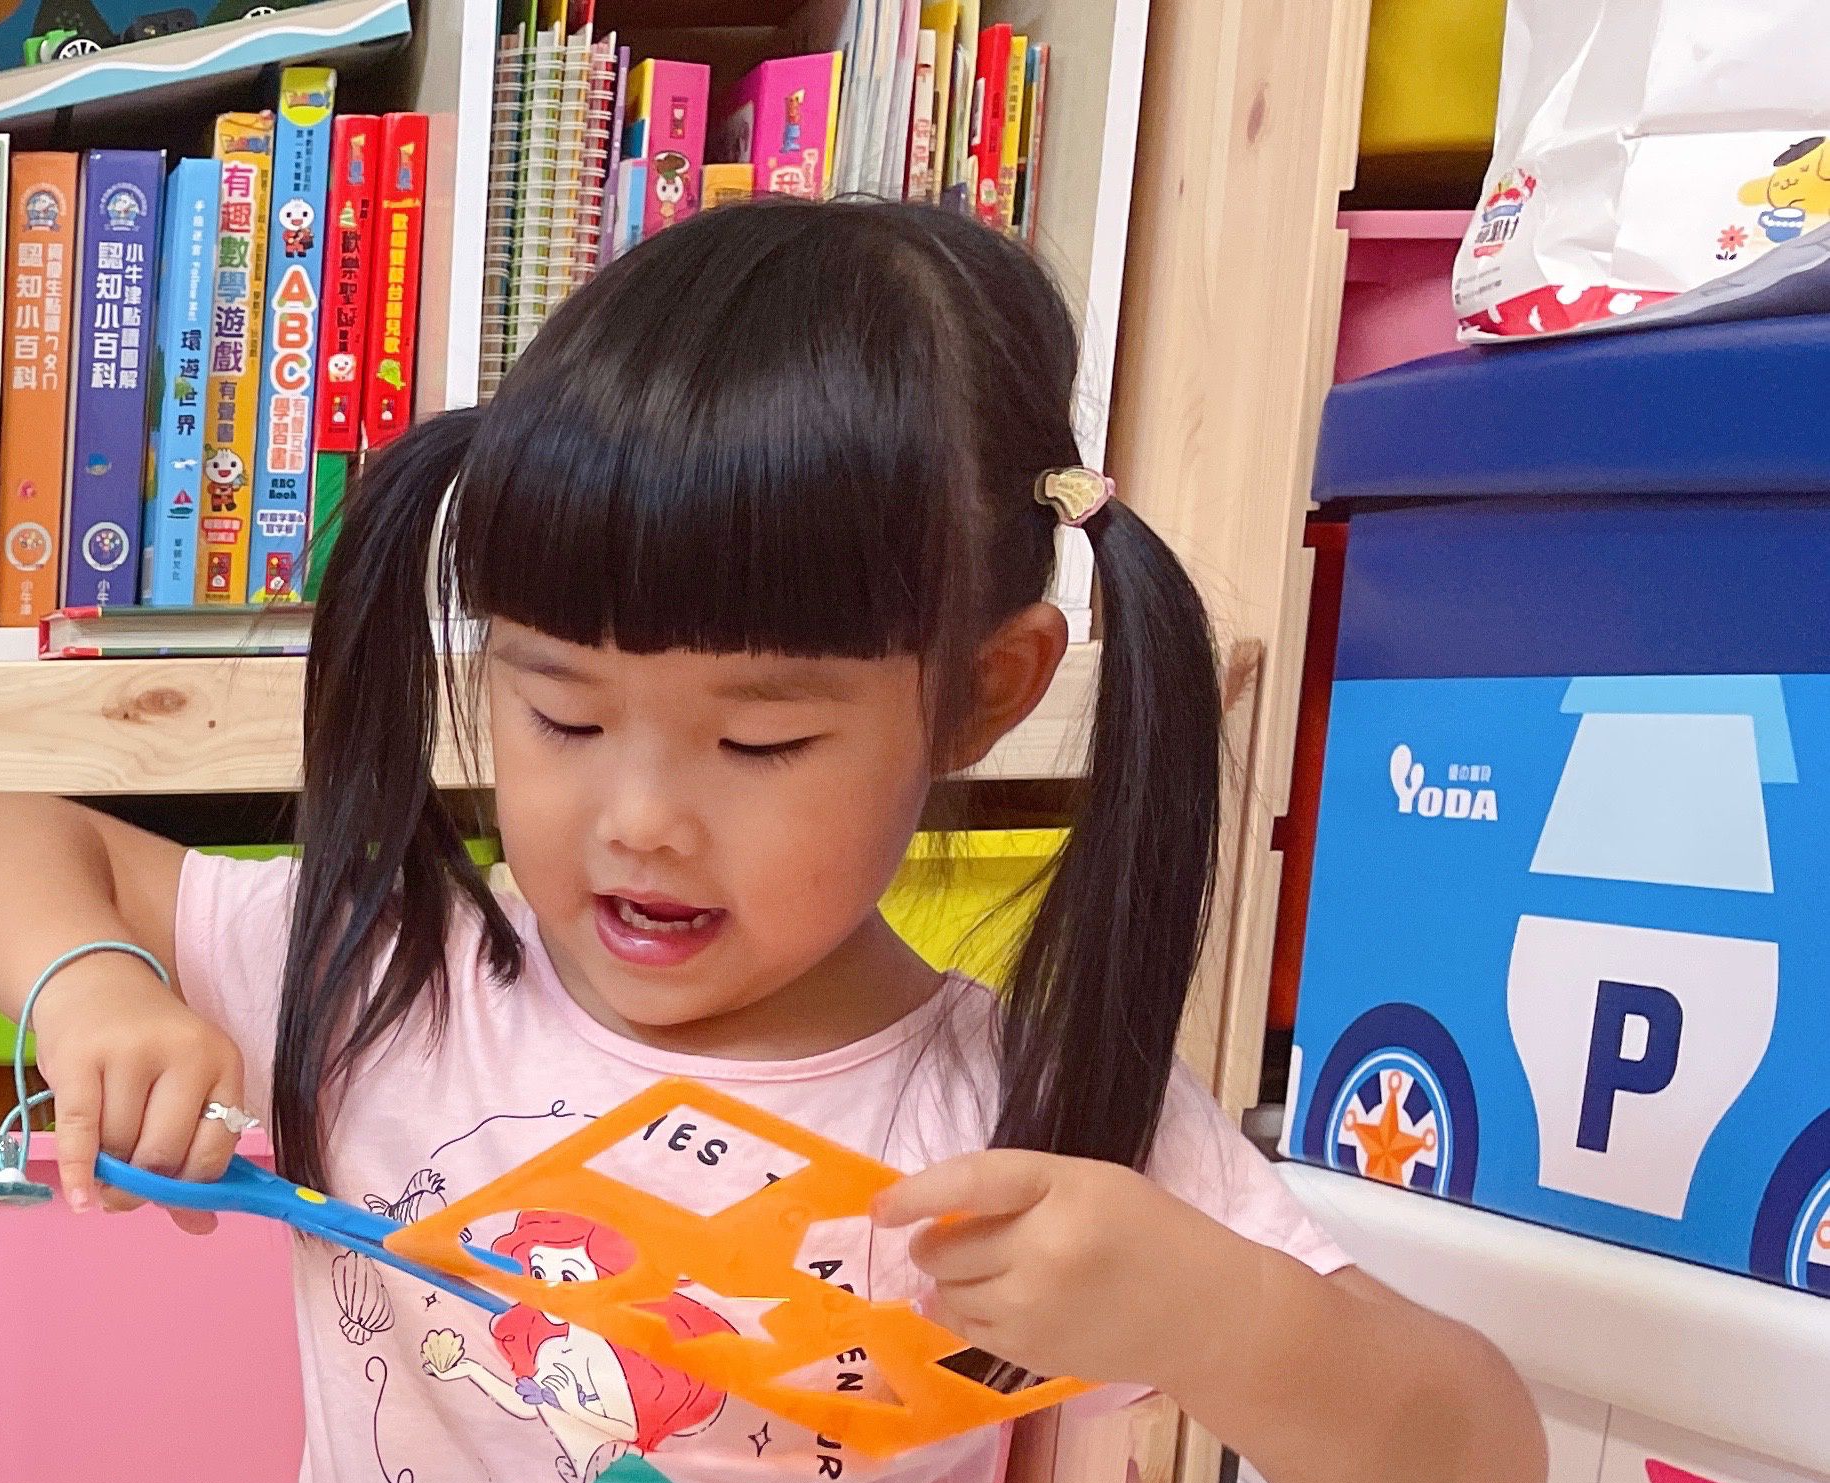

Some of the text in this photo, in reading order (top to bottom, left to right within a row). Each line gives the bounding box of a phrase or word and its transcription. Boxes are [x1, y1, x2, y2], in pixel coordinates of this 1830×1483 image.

[12, 242, 43, 390] 認知小百科
[91, 241, 124, 389] 認知小百科
[212, 164, 254, 374] 有趣數學遊戲
[274, 268, 314, 392] ABC
[1575, 979, 1685, 1154] P
